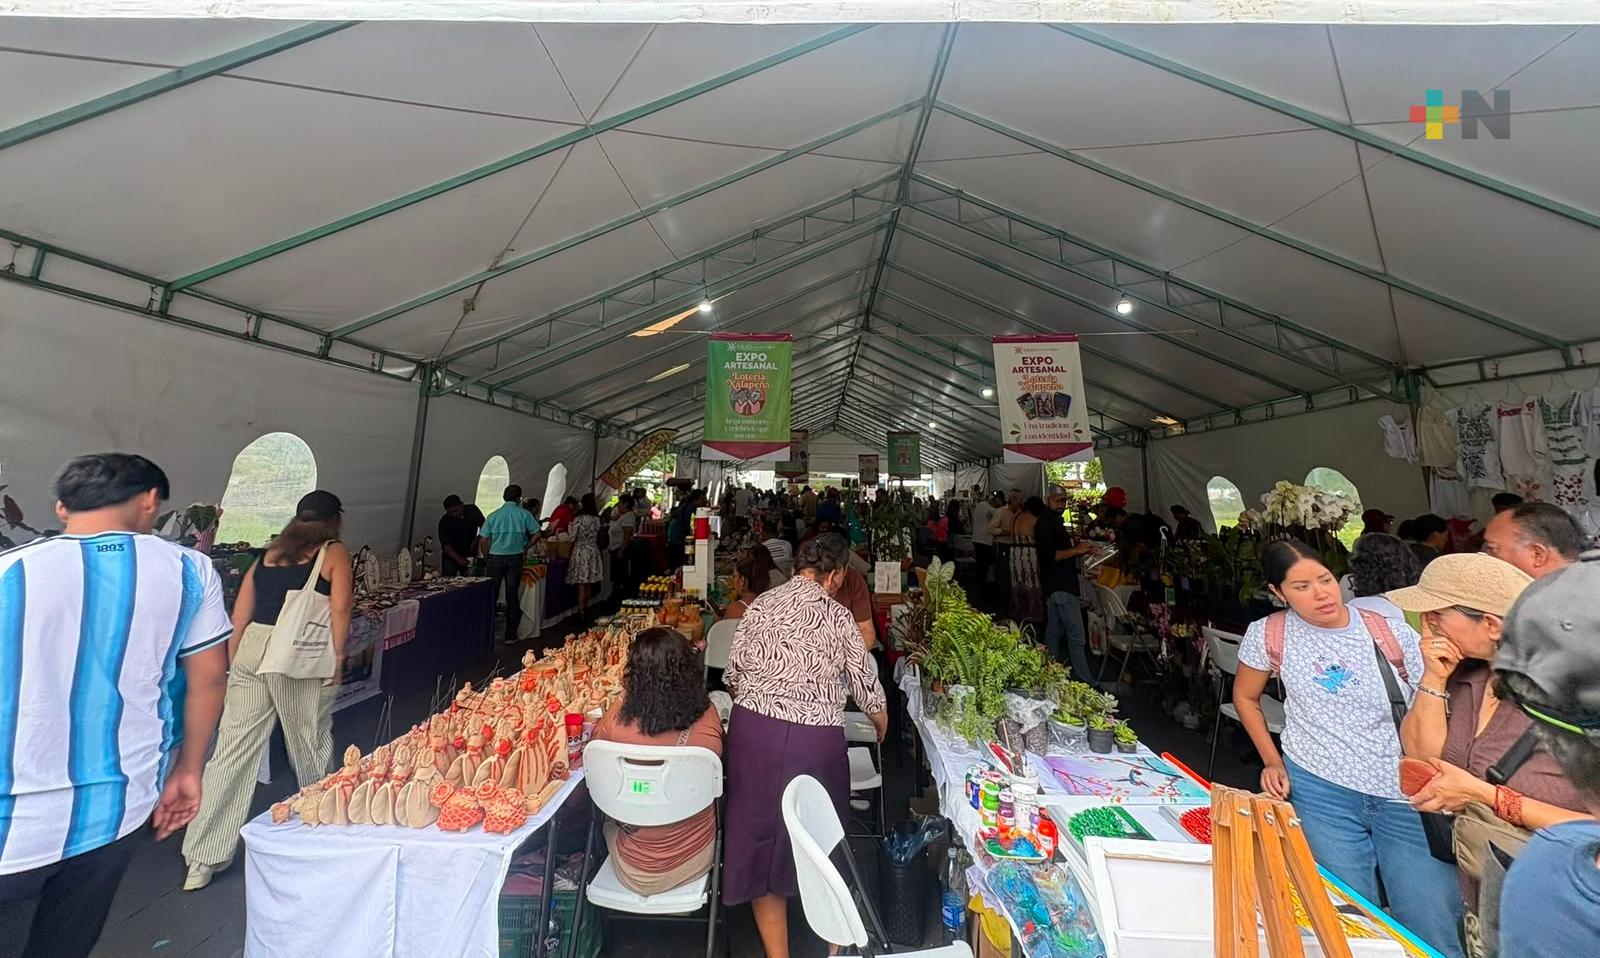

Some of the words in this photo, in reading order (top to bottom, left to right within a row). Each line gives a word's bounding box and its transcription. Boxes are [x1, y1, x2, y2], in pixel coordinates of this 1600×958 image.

[735, 352, 767, 361] EXPO
[1021, 356, 1053, 365] EXPO
[724, 362, 778, 370] ARTESANAL
[1012, 365, 1067, 374] ARTESANAL
[96, 543, 125, 552] 1893
